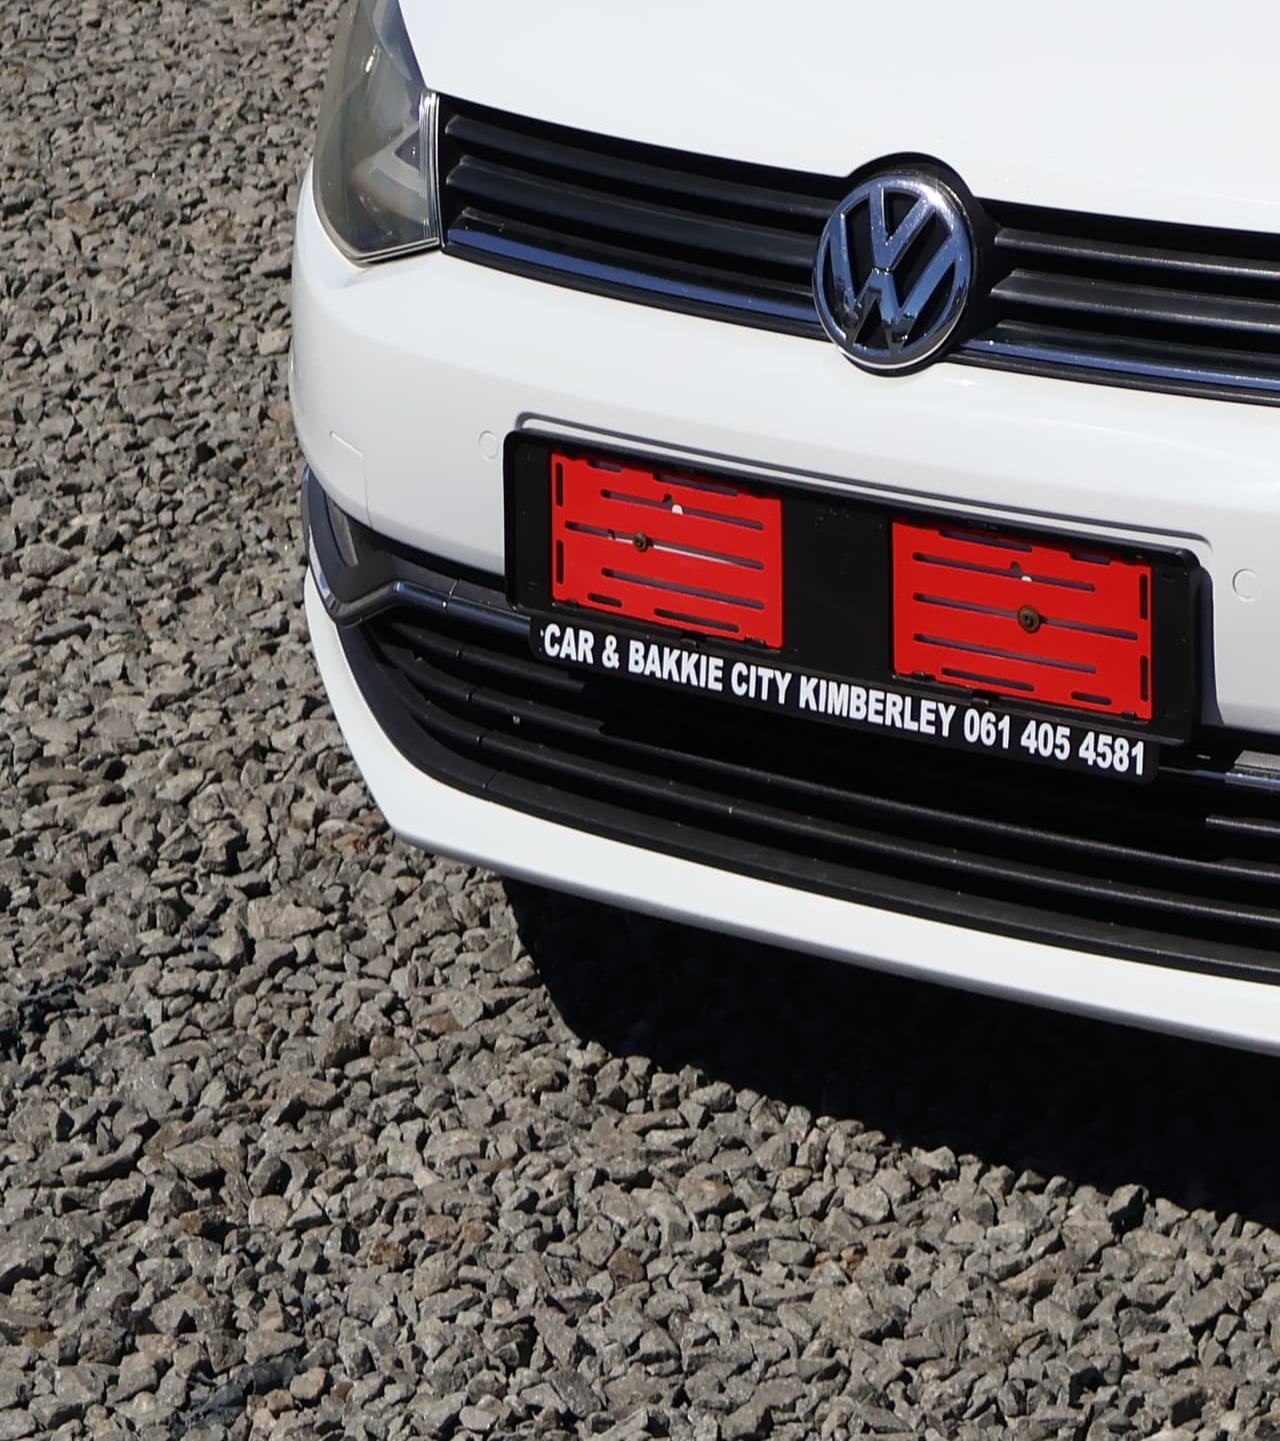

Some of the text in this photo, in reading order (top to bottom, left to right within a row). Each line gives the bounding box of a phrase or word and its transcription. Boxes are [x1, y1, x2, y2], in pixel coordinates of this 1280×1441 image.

[812, 172, 976, 368] VW
[544, 623, 1144, 776] CAR & BAKKIE CITY KIMBERLEY 061 405 4581
